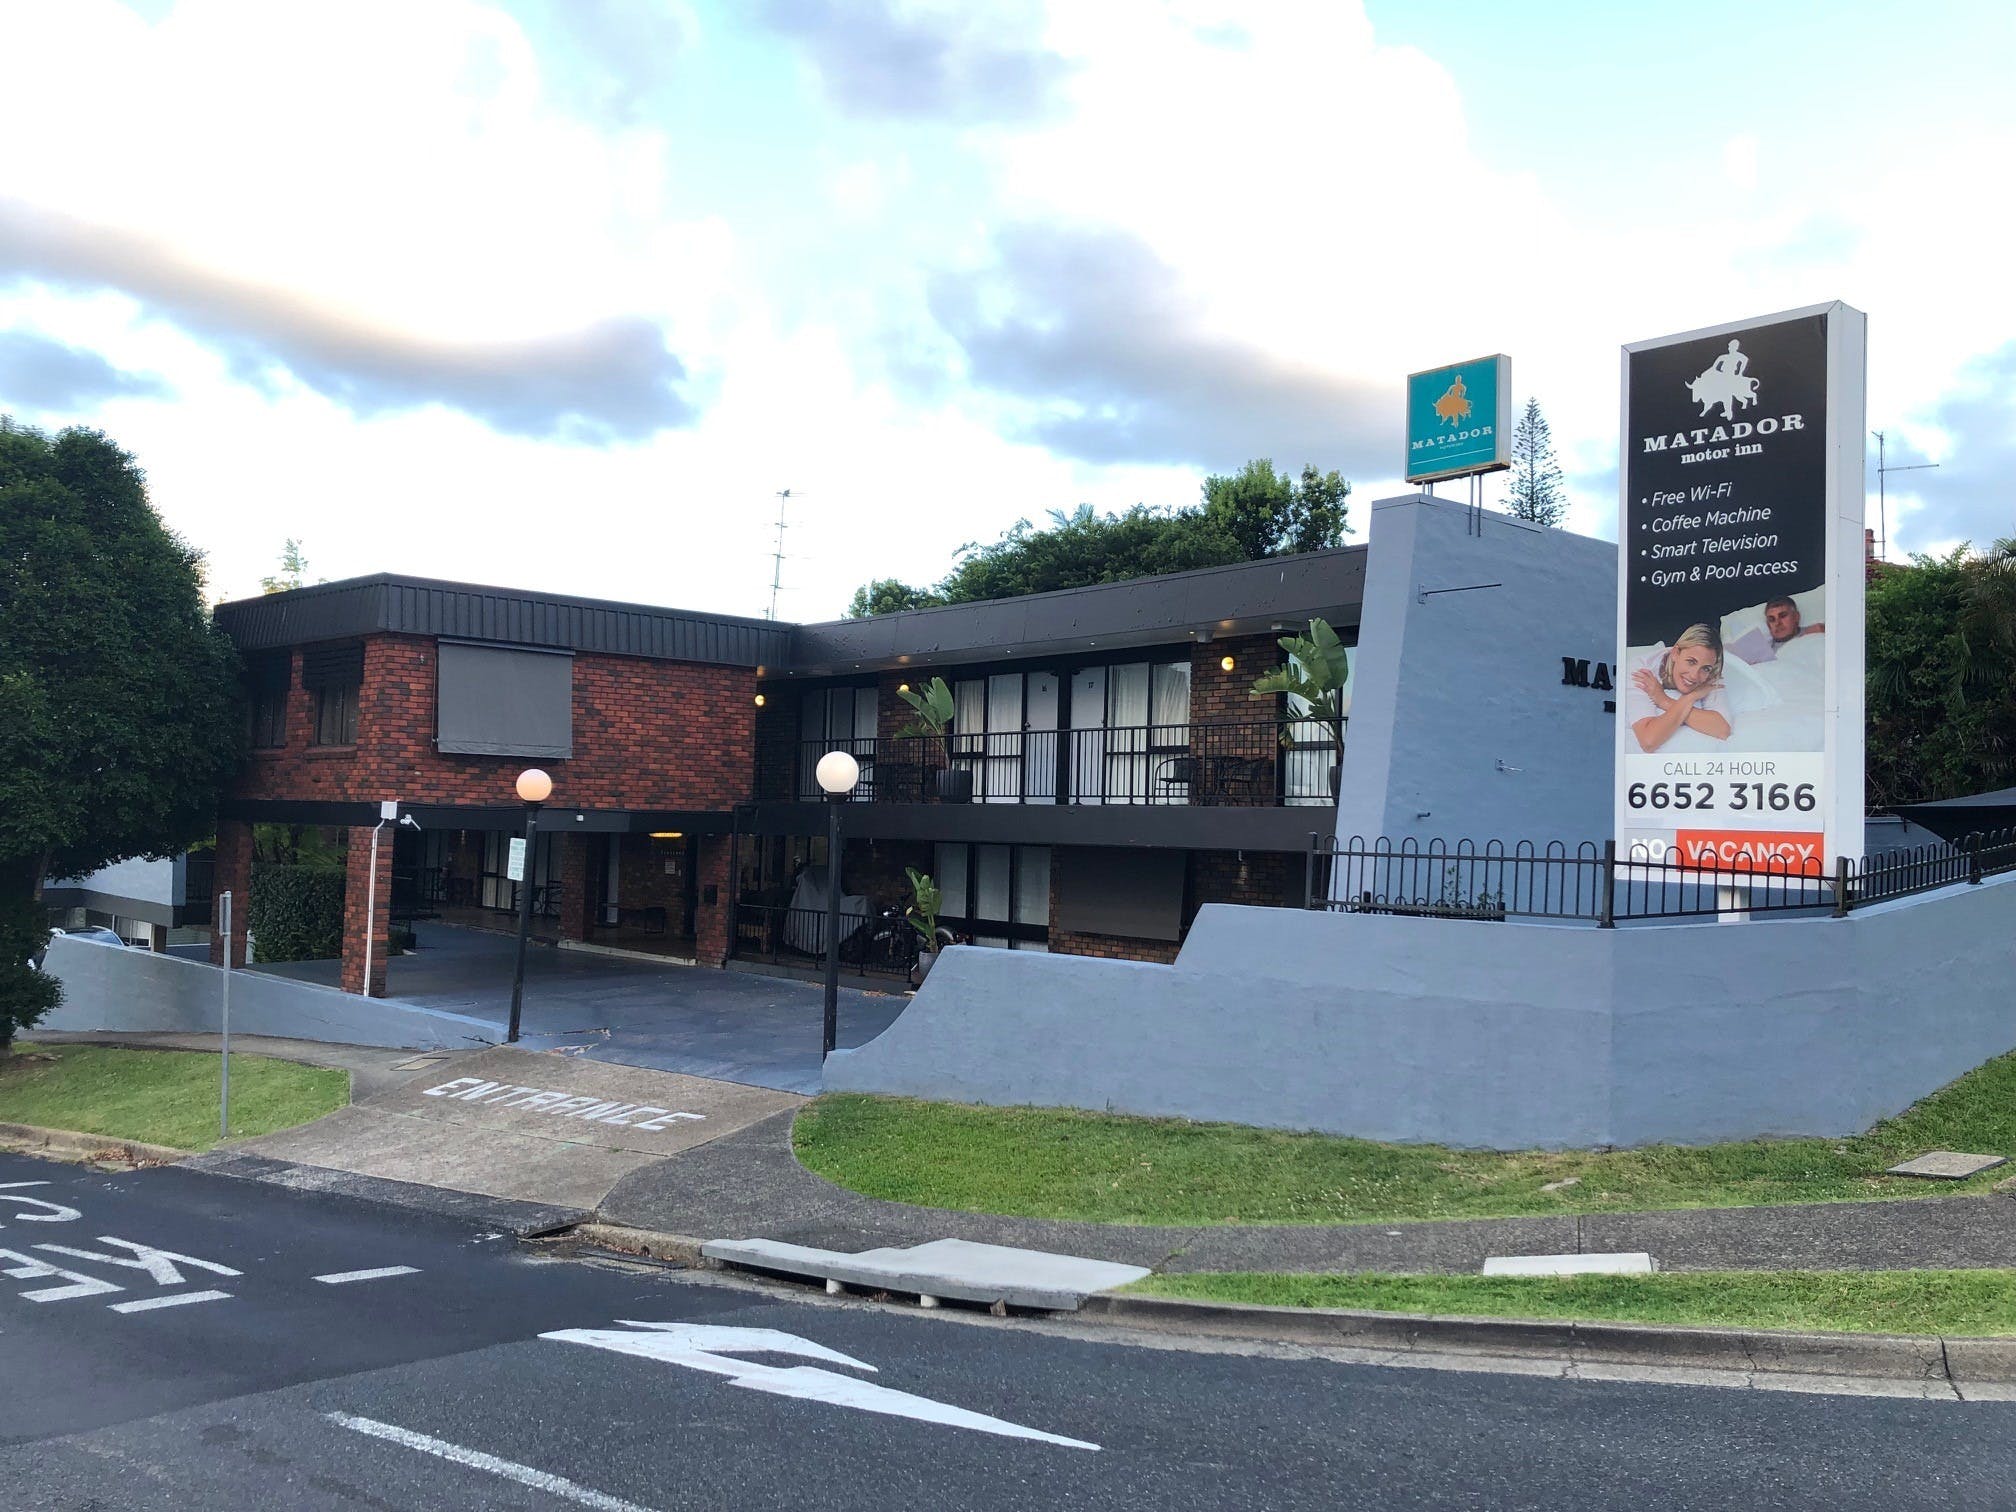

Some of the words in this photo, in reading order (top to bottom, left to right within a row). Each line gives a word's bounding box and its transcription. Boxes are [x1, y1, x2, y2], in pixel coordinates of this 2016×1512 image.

[1411, 426, 1493, 449] MATADOR
[1643, 414, 1805, 453] MATADOR
[1681, 447, 1730, 464] motor
[1734, 443, 1763, 456] inn
[1651, 491, 1685, 507] Free
[1690, 482, 1732, 502] Wi-Fi
[1652, 514, 1701, 532] Coffee
[1705, 507, 1771, 527] Machine
[1651, 540, 1698, 559] Smart
[1702, 534, 1778, 554] Television
[1651, 570, 1686, 587] Gym
[1690, 566, 1700, 582] &
[1705, 562, 1741, 580] Pool
[1744, 560, 1798, 577] access
[1561, 656, 1616, 691] MA
[1663, 762, 1702, 776] CALL
[1706, 762, 1724, 776] 24
[1729, 761, 1776, 776] HOUR
[1628, 782, 1715, 810] 6652
[1728, 782, 1816, 812] 3166
[1631, 838, 1667, 859] NO
[1686, 839, 1815, 866] VACANCY
[422, 1077, 706, 1132] ENTRANCE
